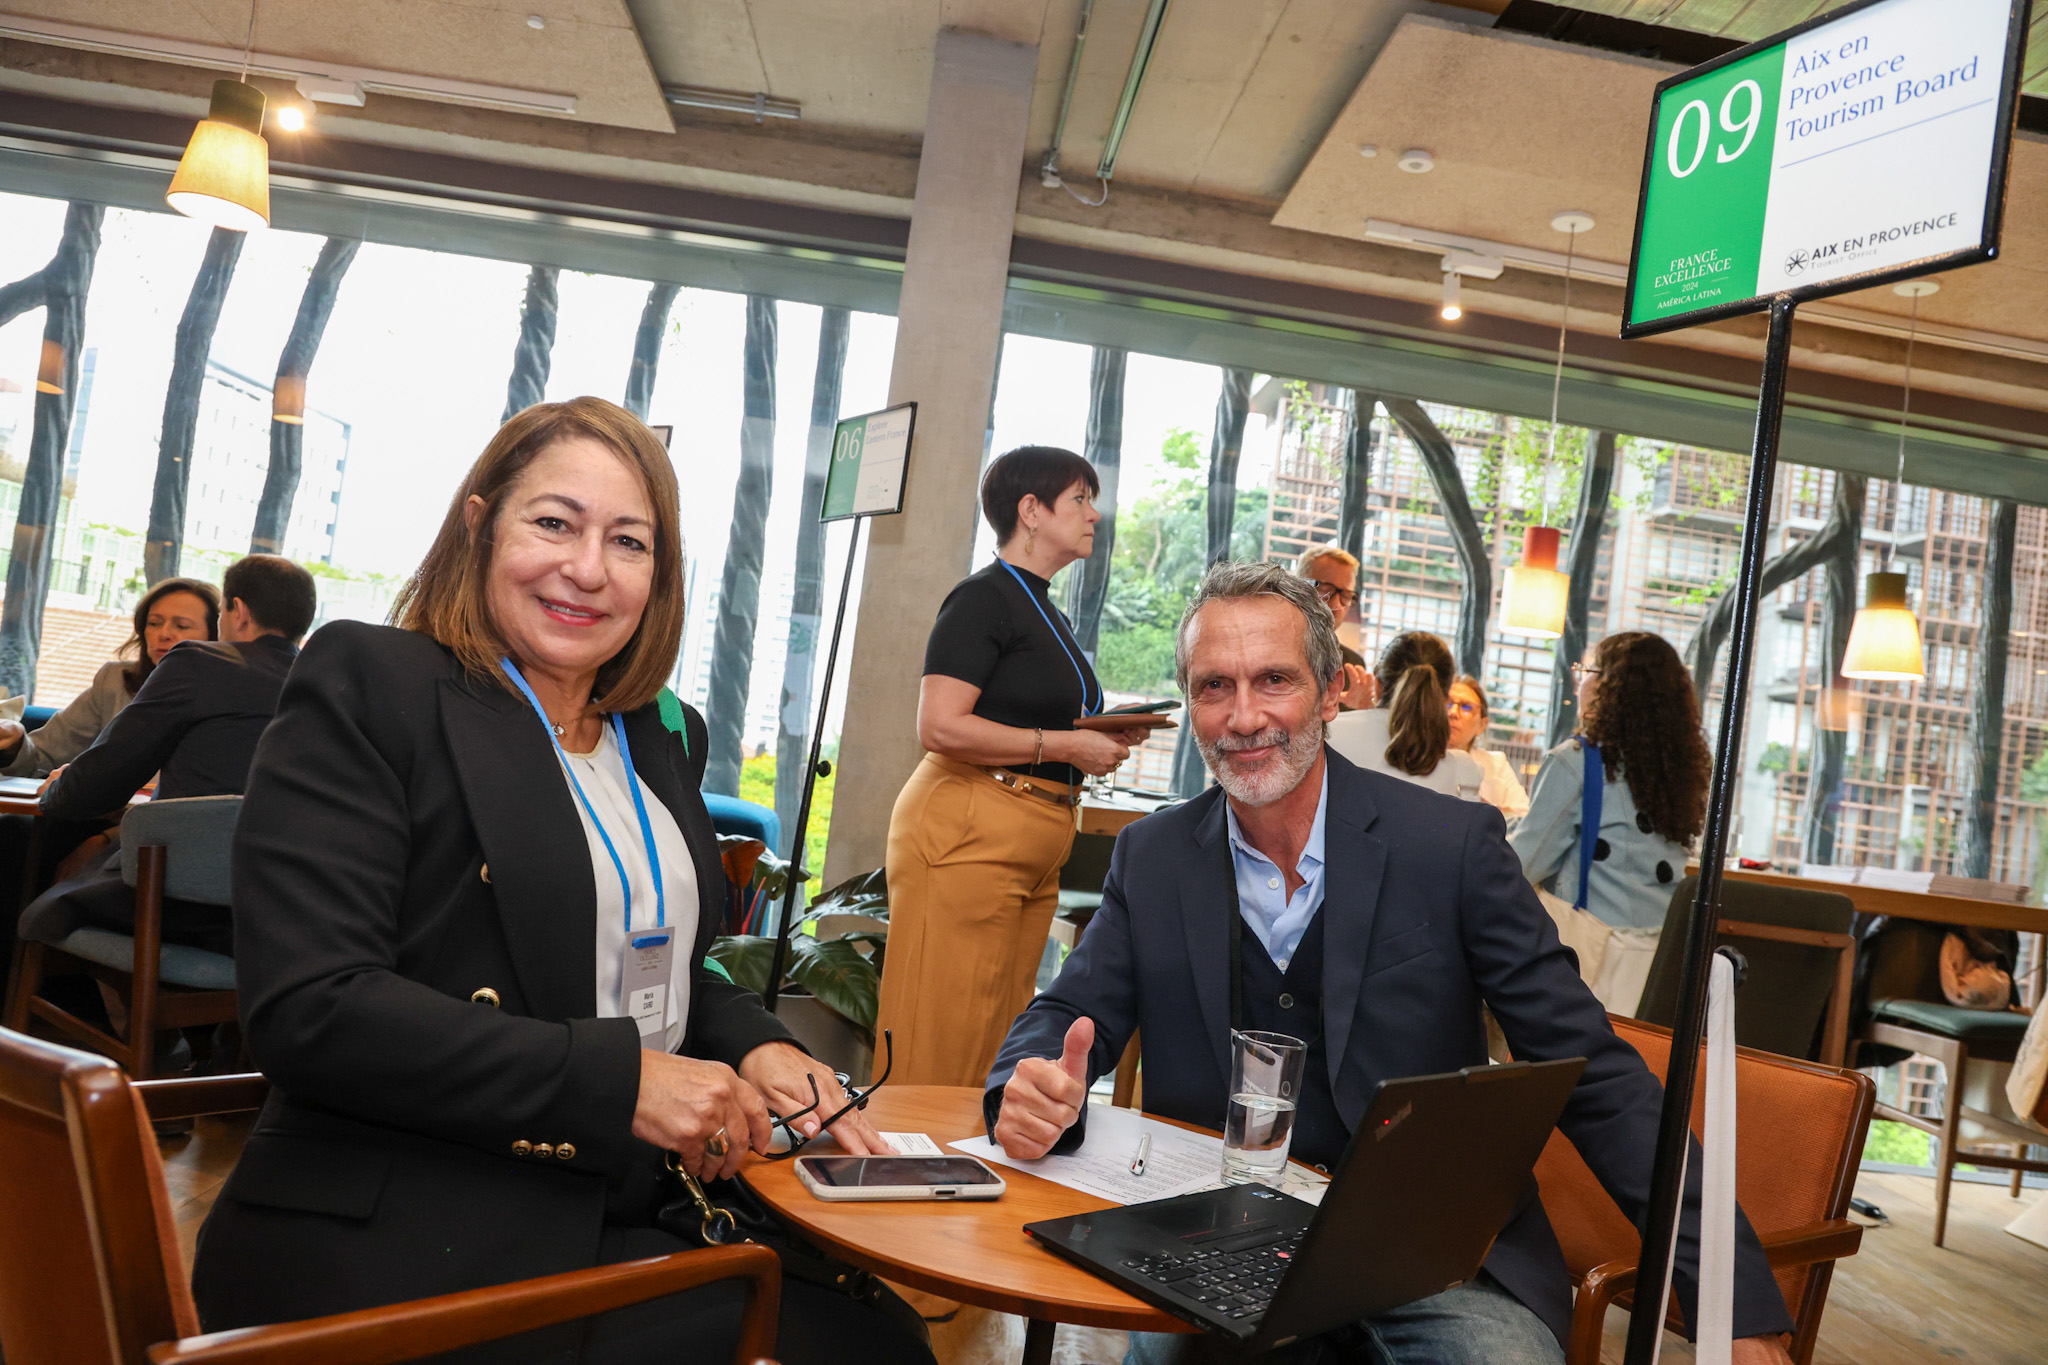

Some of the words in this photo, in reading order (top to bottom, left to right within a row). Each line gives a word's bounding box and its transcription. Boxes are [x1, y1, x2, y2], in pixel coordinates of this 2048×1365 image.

[1792, 49, 1832, 78] Aix
[1839, 35, 1869, 59] en
[1786, 94, 1884, 141] Tourism
[1895, 54, 1979, 105] Board
[1789, 54, 1905, 110] Provence
[1667, 79, 1763, 178] 09
[1812, 243, 1838, 260] AIX
[1843, 236, 1863, 252] EN
[1869, 212, 1958, 246] PROVENCE
[1654, 257, 1732, 288] EXCELLENCE
[1670, 248, 1718, 272] FRANCE
[1657, 295, 1691, 310] AMÉRICA
[1693, 288, 1722, 301] LATINA
[1681, 281, 1699, 292] 2024
[836, 427, 862, 462] 06
